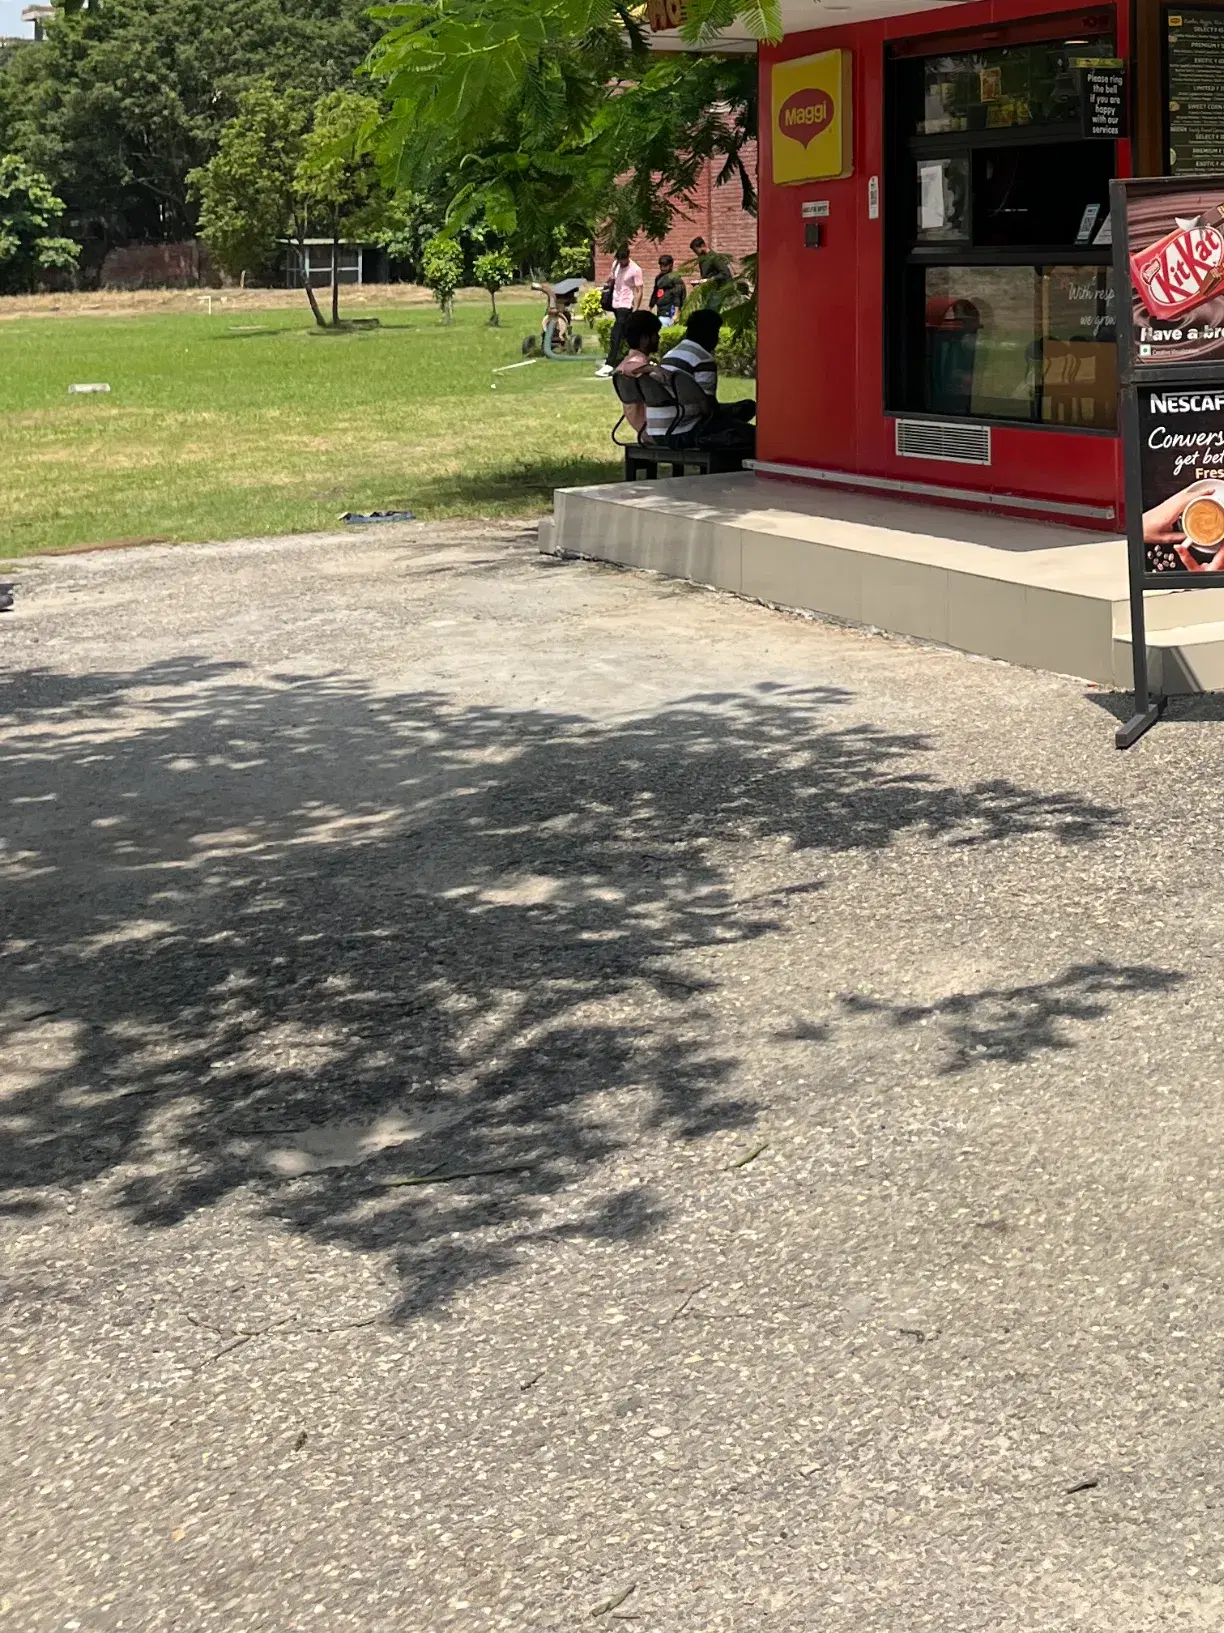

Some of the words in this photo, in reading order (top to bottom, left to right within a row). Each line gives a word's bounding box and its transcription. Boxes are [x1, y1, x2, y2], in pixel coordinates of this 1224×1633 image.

[1087, 74, 1108, 83] Please
[1110, 75, 1123, 86] ring
[1093, 84, 1104, 93] the
[1105, 84, 1118, 94] bell
[1090, 94, 1095, 103] if
[1096, 96, 1108, 104] you
[785, 101, 827, 126] Maggi
[1095, 103, 1116, 116] happy
[1092, 114, 1107, 124] with
[1092, 125, 1119, 135] services
[1095, 287, 1116, 307] resp
[1140, 326, 1183, 342] Have
[1187, 327, 1199, 339] a
[1174, 453, 1196, 476] get
